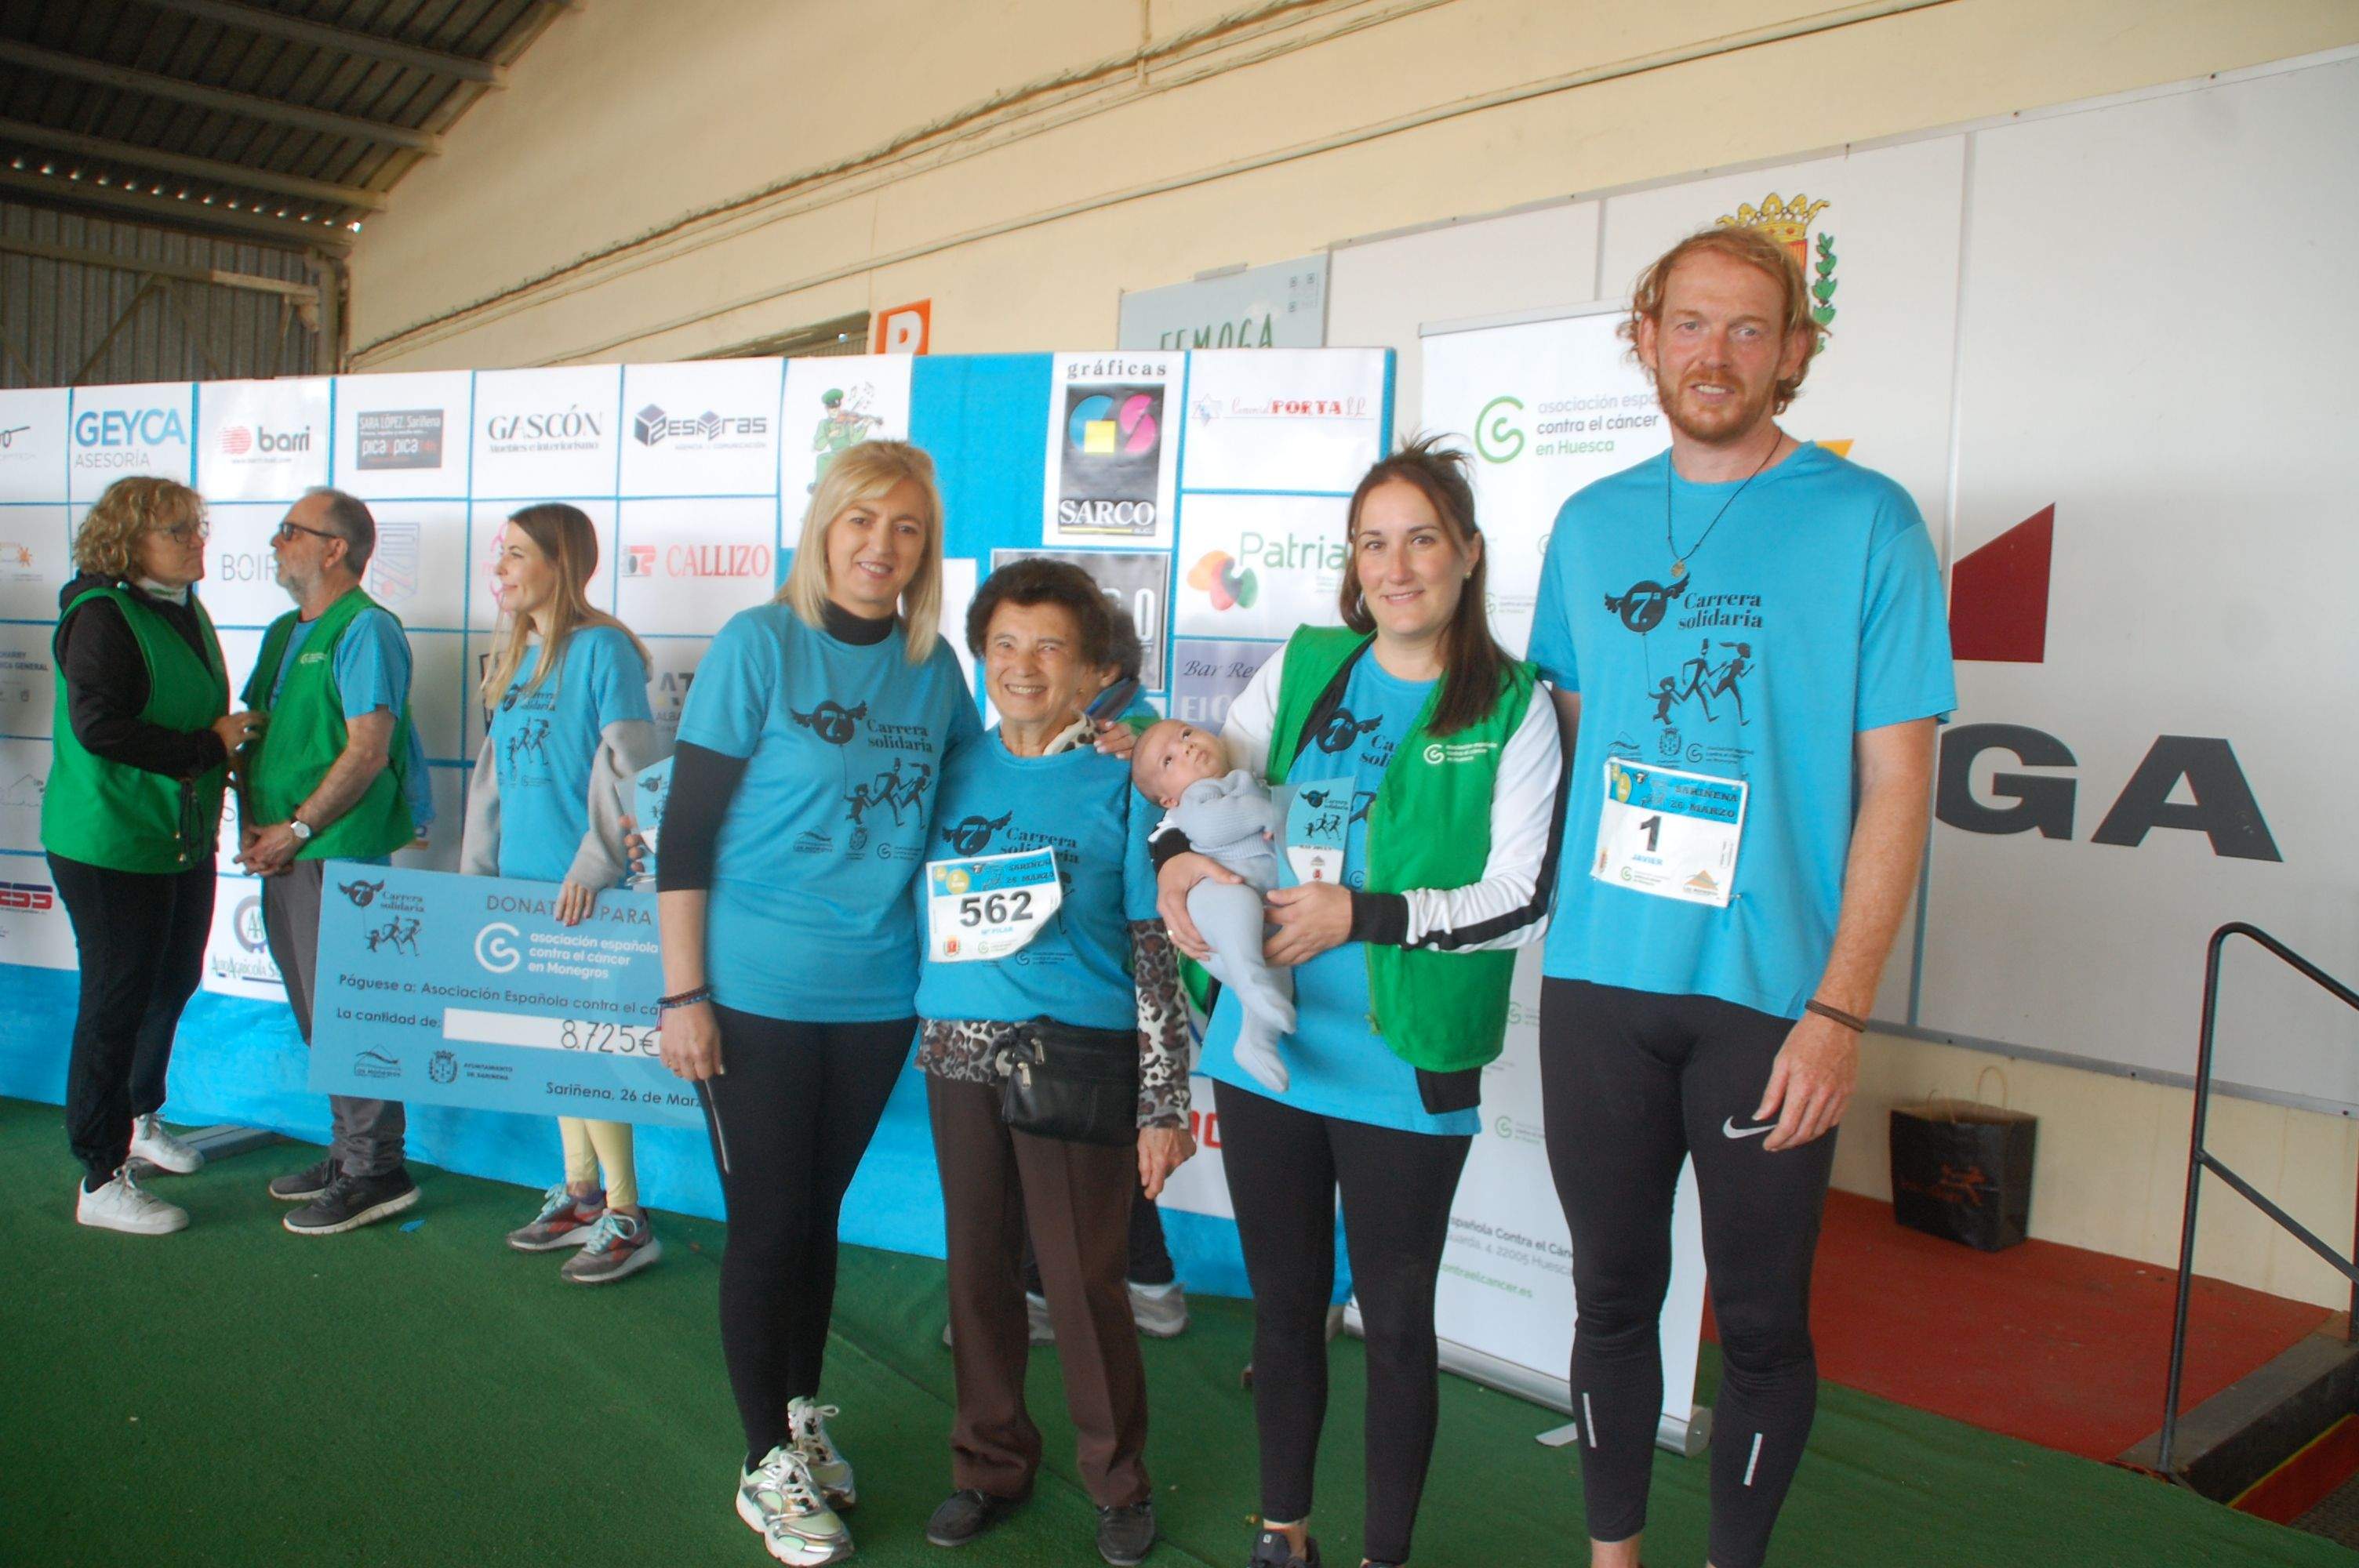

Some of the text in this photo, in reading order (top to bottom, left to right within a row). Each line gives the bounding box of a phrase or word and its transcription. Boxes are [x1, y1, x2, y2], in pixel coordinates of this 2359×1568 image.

[1067, 359, 1167, 379] gráficas
[1272, 400, 1342, 416] PORTA
[1538, 394, 1618, 414] asociación
[75, 409, 187, 447] GEYCA
[488, 404, 603, 441] GASCÓN
[1537, 413, 1659, 435] contra el cáncer
[257, 425, 311, 452] barri
[1536, 438, 1615, 456] en Huesca
[75, 450, 151, 469] ASESORÍA
[1060, 499, 1155, 525] SARCO
[666, 544, 772, 579] CALLIZO
[1684, 592, 1762, 609] Carrera
[1678, 609, 1763, 630] solidaria
[1183, 659, 1261, 678] Bar Re
[867, 718, 929, 737] Carrera
[867, 735, 932, 753] solidaria
[1670, 800, 1736, 818] 26 MARZO
[1006, 826, 1078, 849] Carrera
[1639, 815, 1662, 852] 1
[382, 891, 423, 902] Carrera
[380, 902, 424, 913] solidaria
[599, 906, 652, 925] PARA
[960, 890, 1034, 927] 562
[530, 931, 659, 954] asociación española
[529, 946, 631, 966] contra el cáncer
[528, 961, 609, 979] en Monegros
[339, 974, 399, 990] Páguese
[404, 981, 416, 993] a:
[421, 982, 500, 1000] Asociación
[505, 990, 569, 1007] Española
[573, 996, 619, 1012] contra
[623, 1002, 636, 1013] el
[337, 1007, 351, 1018] La
[355, 1010, 416, 1025] cantidad
[620, 1089, 638, 1102] 26
[642, 1091, 662, 1104] de
[1495, 1228, 1532, 1247] Contra
[1536, 1241, 1547, 1252] el
